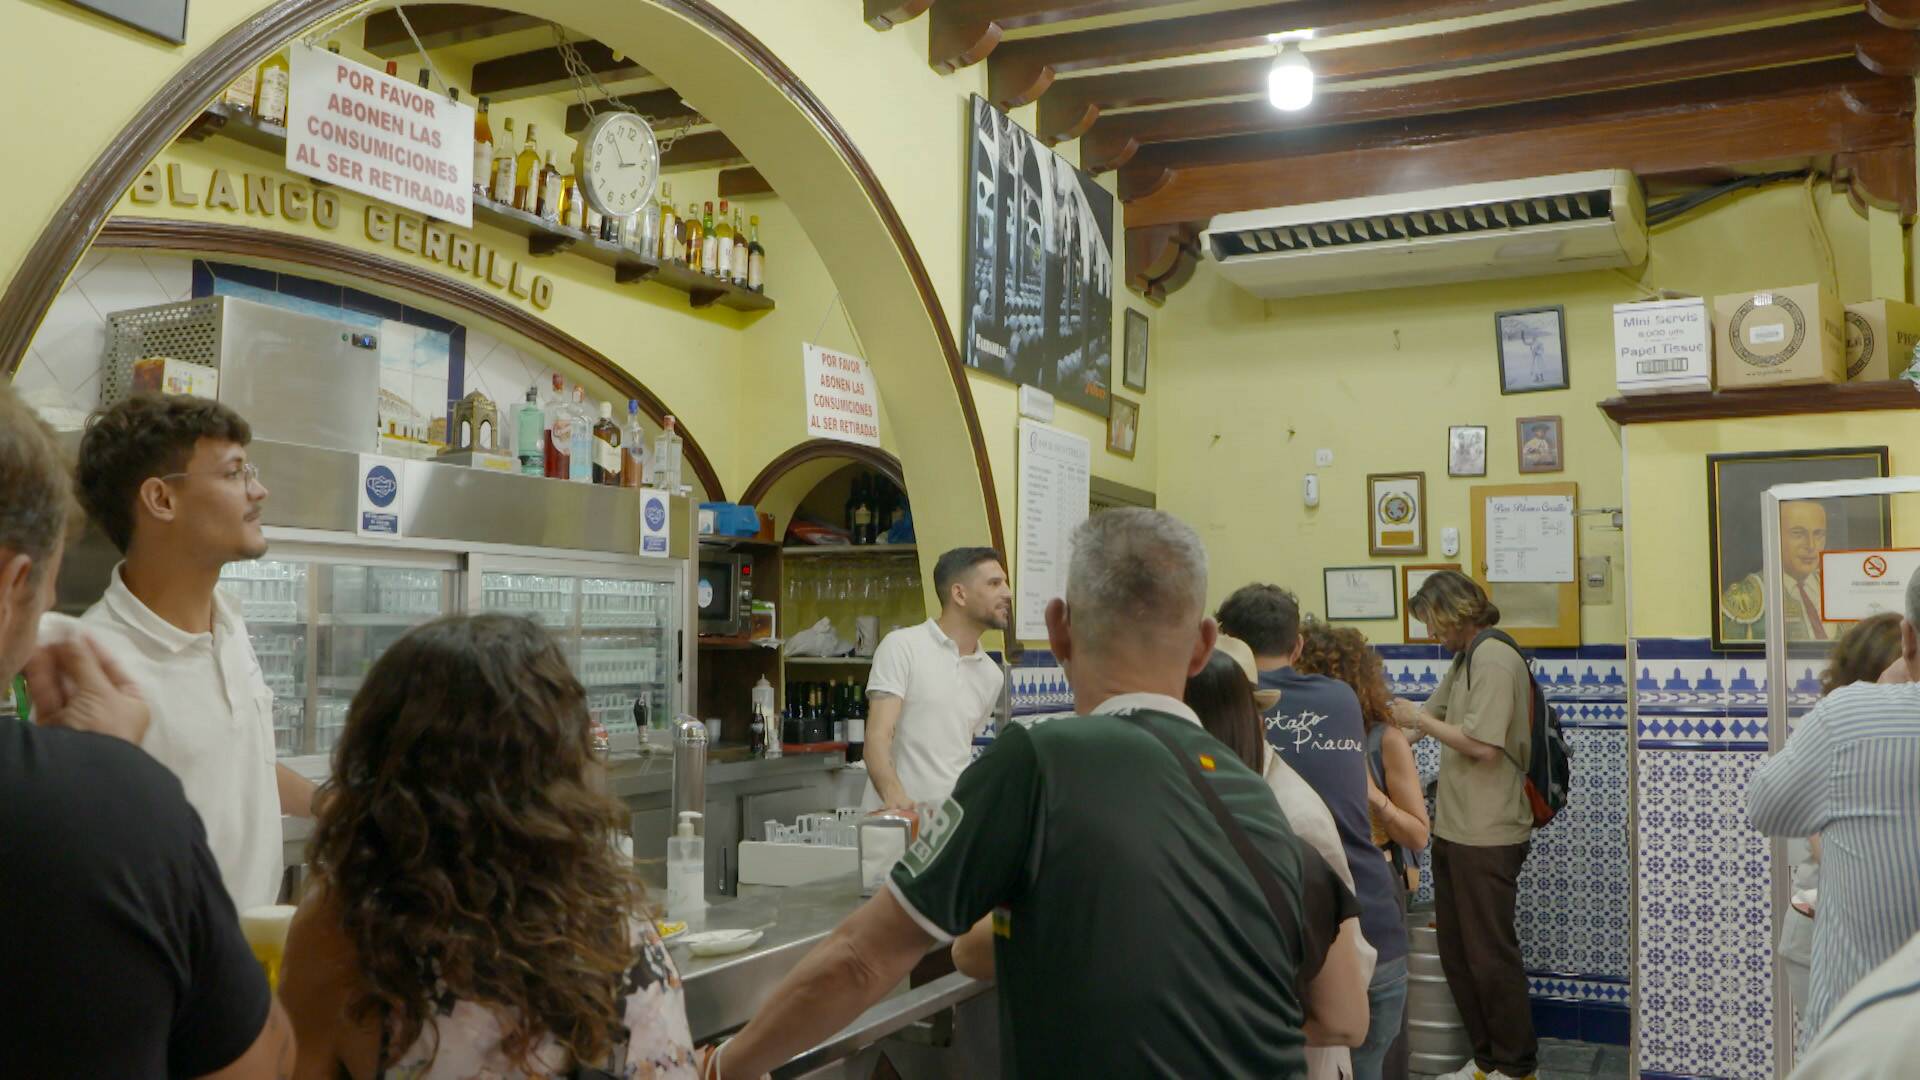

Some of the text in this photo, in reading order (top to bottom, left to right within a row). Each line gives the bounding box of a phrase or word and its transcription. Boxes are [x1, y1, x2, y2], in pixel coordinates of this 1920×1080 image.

[337, 65, 435, 119] POR FAVOR
[328, 93, 442, 149] ABONEN LAS
[307, 116, 459, 184] CONSUMICIONES
[296, 144, 466, 215] AL SER RETIRADAS
[130, 163, 554, 311] BLANCO CERRILLO
[1623, 316, 1650, 327] Mini
[1621, 343, 1704, 357] Papel Tissue
[821, 353, 861, 373] POR FAVOR
[820, 374, 865, 396] ABONEN LAS
[814, 393, 873, 417] CONSUMICIONES
[811, 415, 877, 438] AL SER RETIRADAS
[1291, 727, 1362, 754] Piacere
